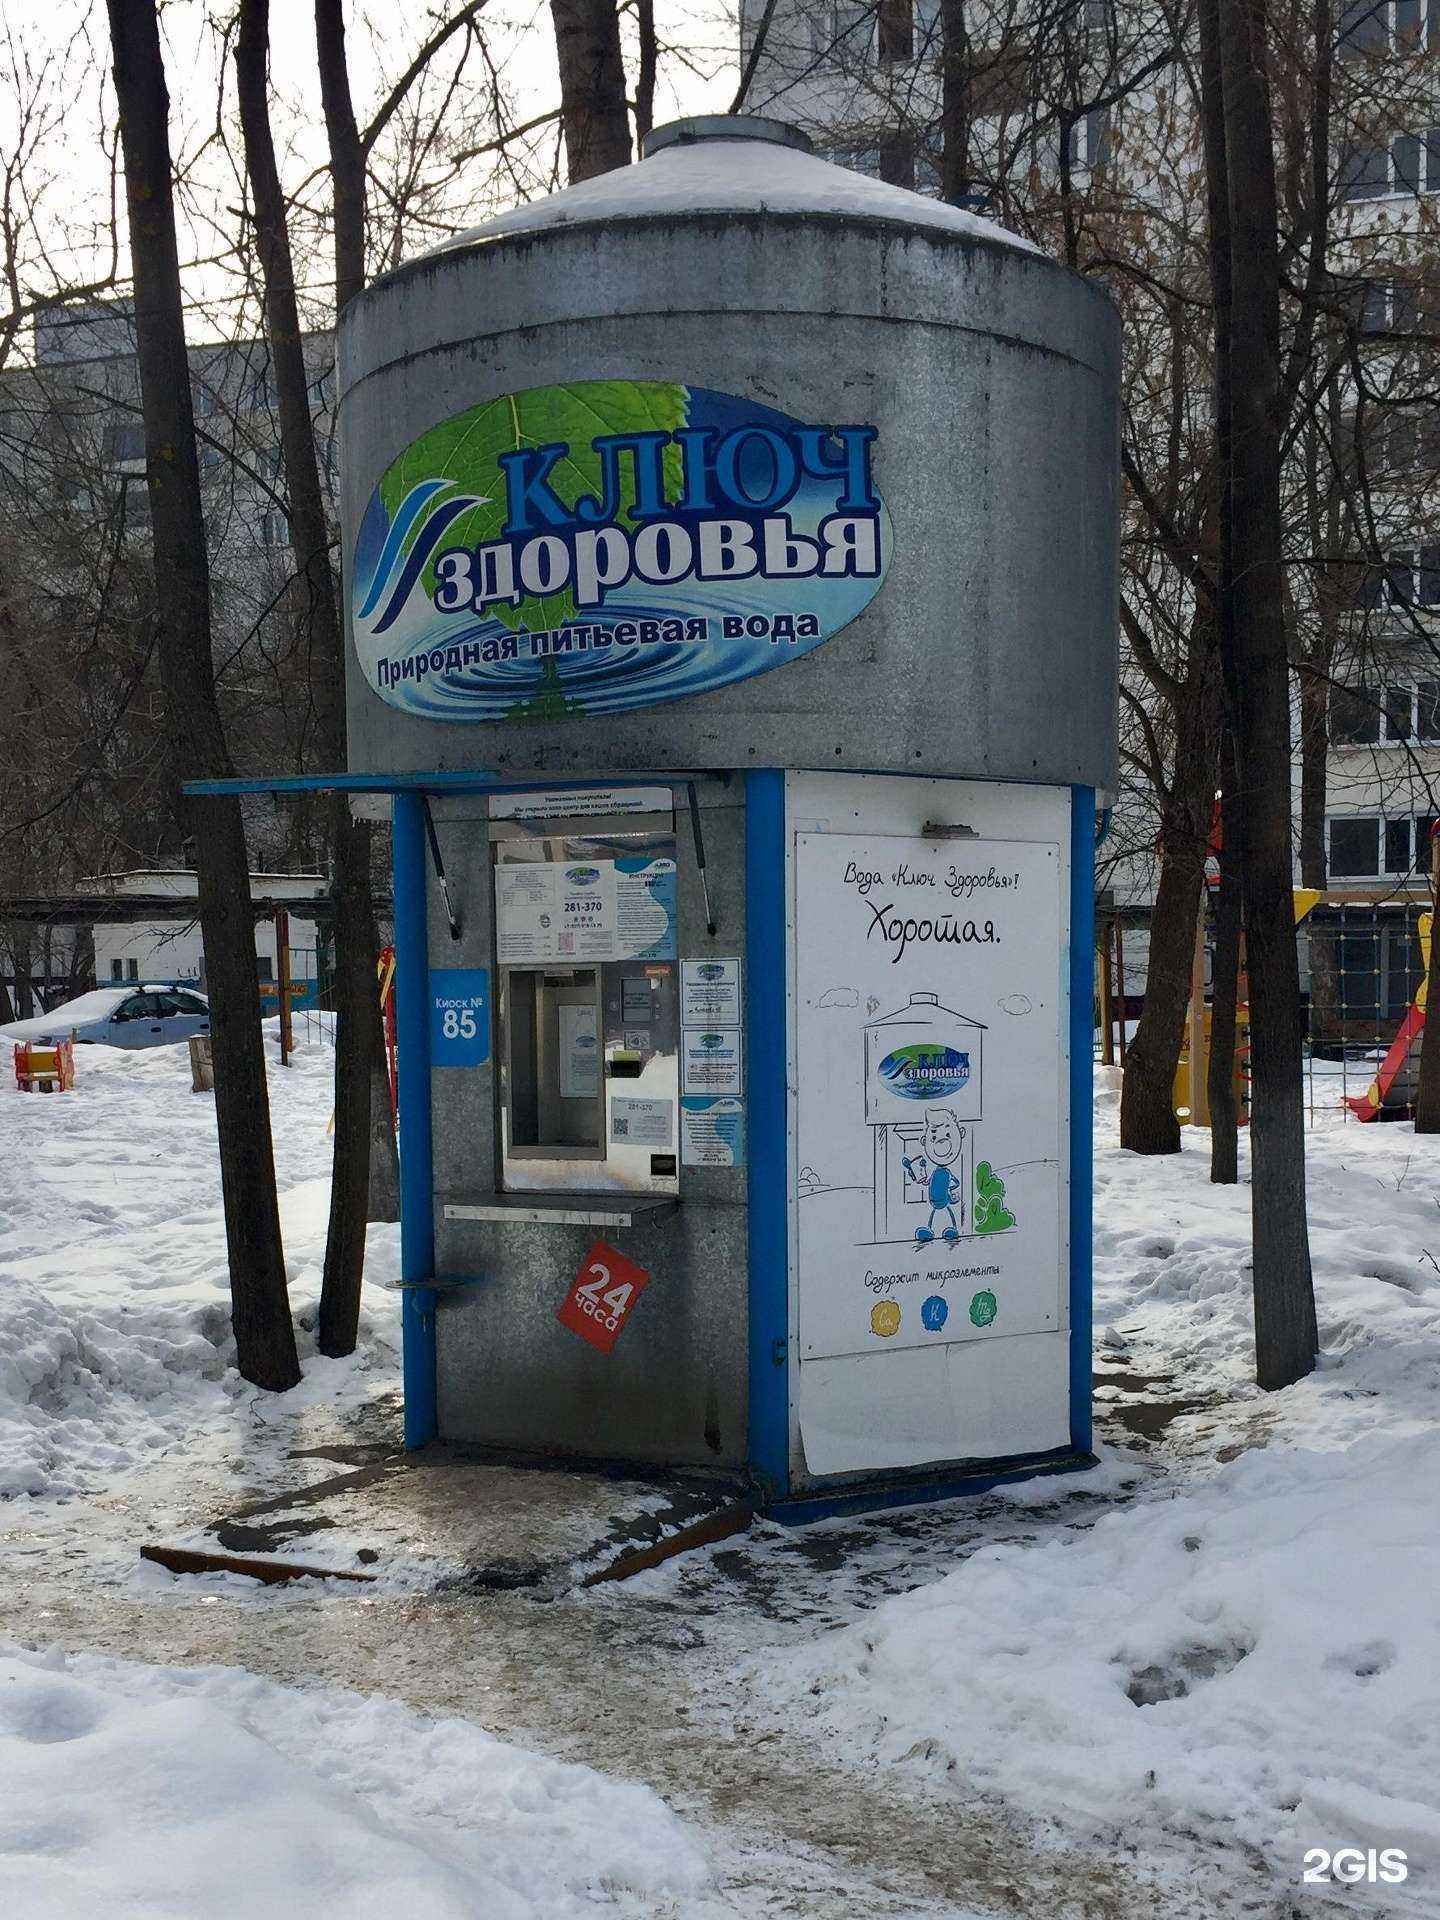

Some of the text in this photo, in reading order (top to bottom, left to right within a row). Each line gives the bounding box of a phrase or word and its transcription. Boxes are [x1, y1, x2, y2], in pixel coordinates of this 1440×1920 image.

[499, 423, 880, 537] КЛЮЧ
[435, 515, 882, 612] здоровья
[376, 613, 820, 689] Природная питьевая вода
[843, 862, 884, 894] Вода
[891, 864, 936, 887] «Ключ
[564, 901, 603, 913] 281-370
[443, 1009, 477, 1039] 85
[577, 1263, 634, 1319] 24
[864, 1270, 920, 1294] Содержит
[575, 1291, 619, 1332] часа
